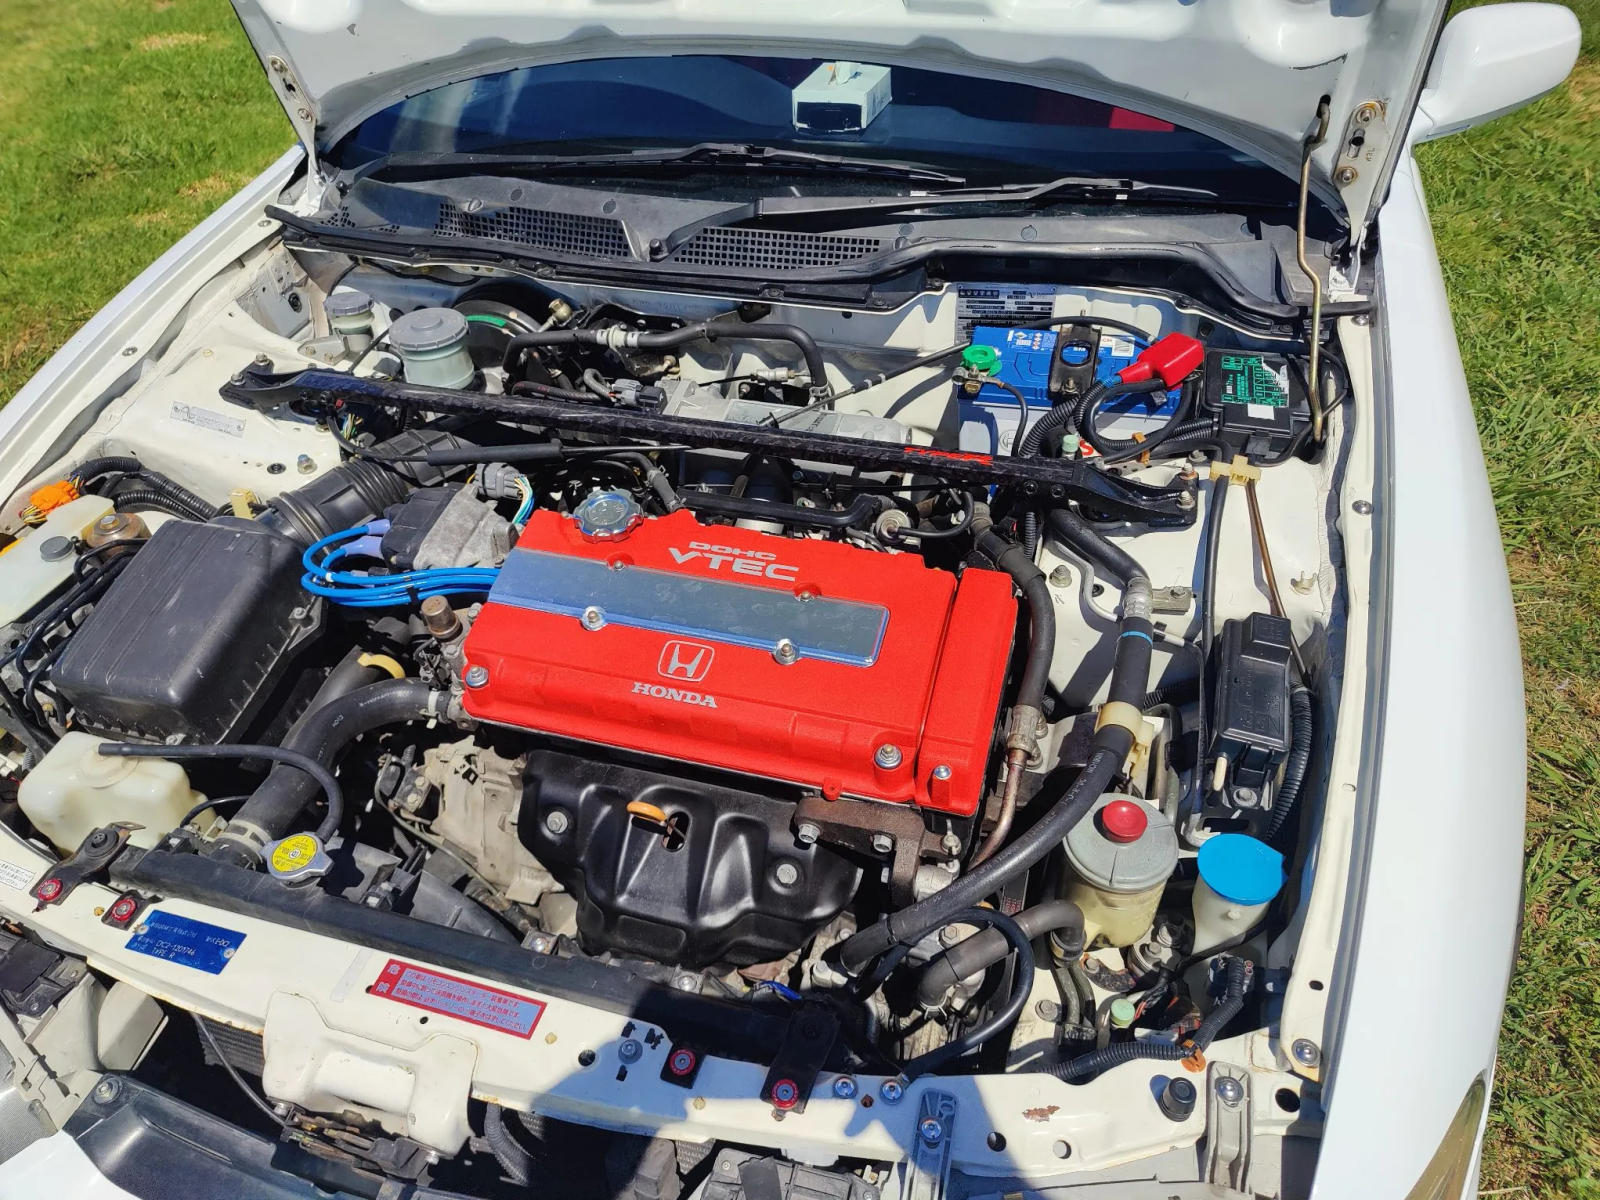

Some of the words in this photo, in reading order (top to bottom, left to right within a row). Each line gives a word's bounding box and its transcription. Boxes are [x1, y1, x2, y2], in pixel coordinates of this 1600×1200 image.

[689, 541, 777, 561] DOHC
[668, 547, 799, 582] VTEC
[631, 682, 718, 708] HONDA
